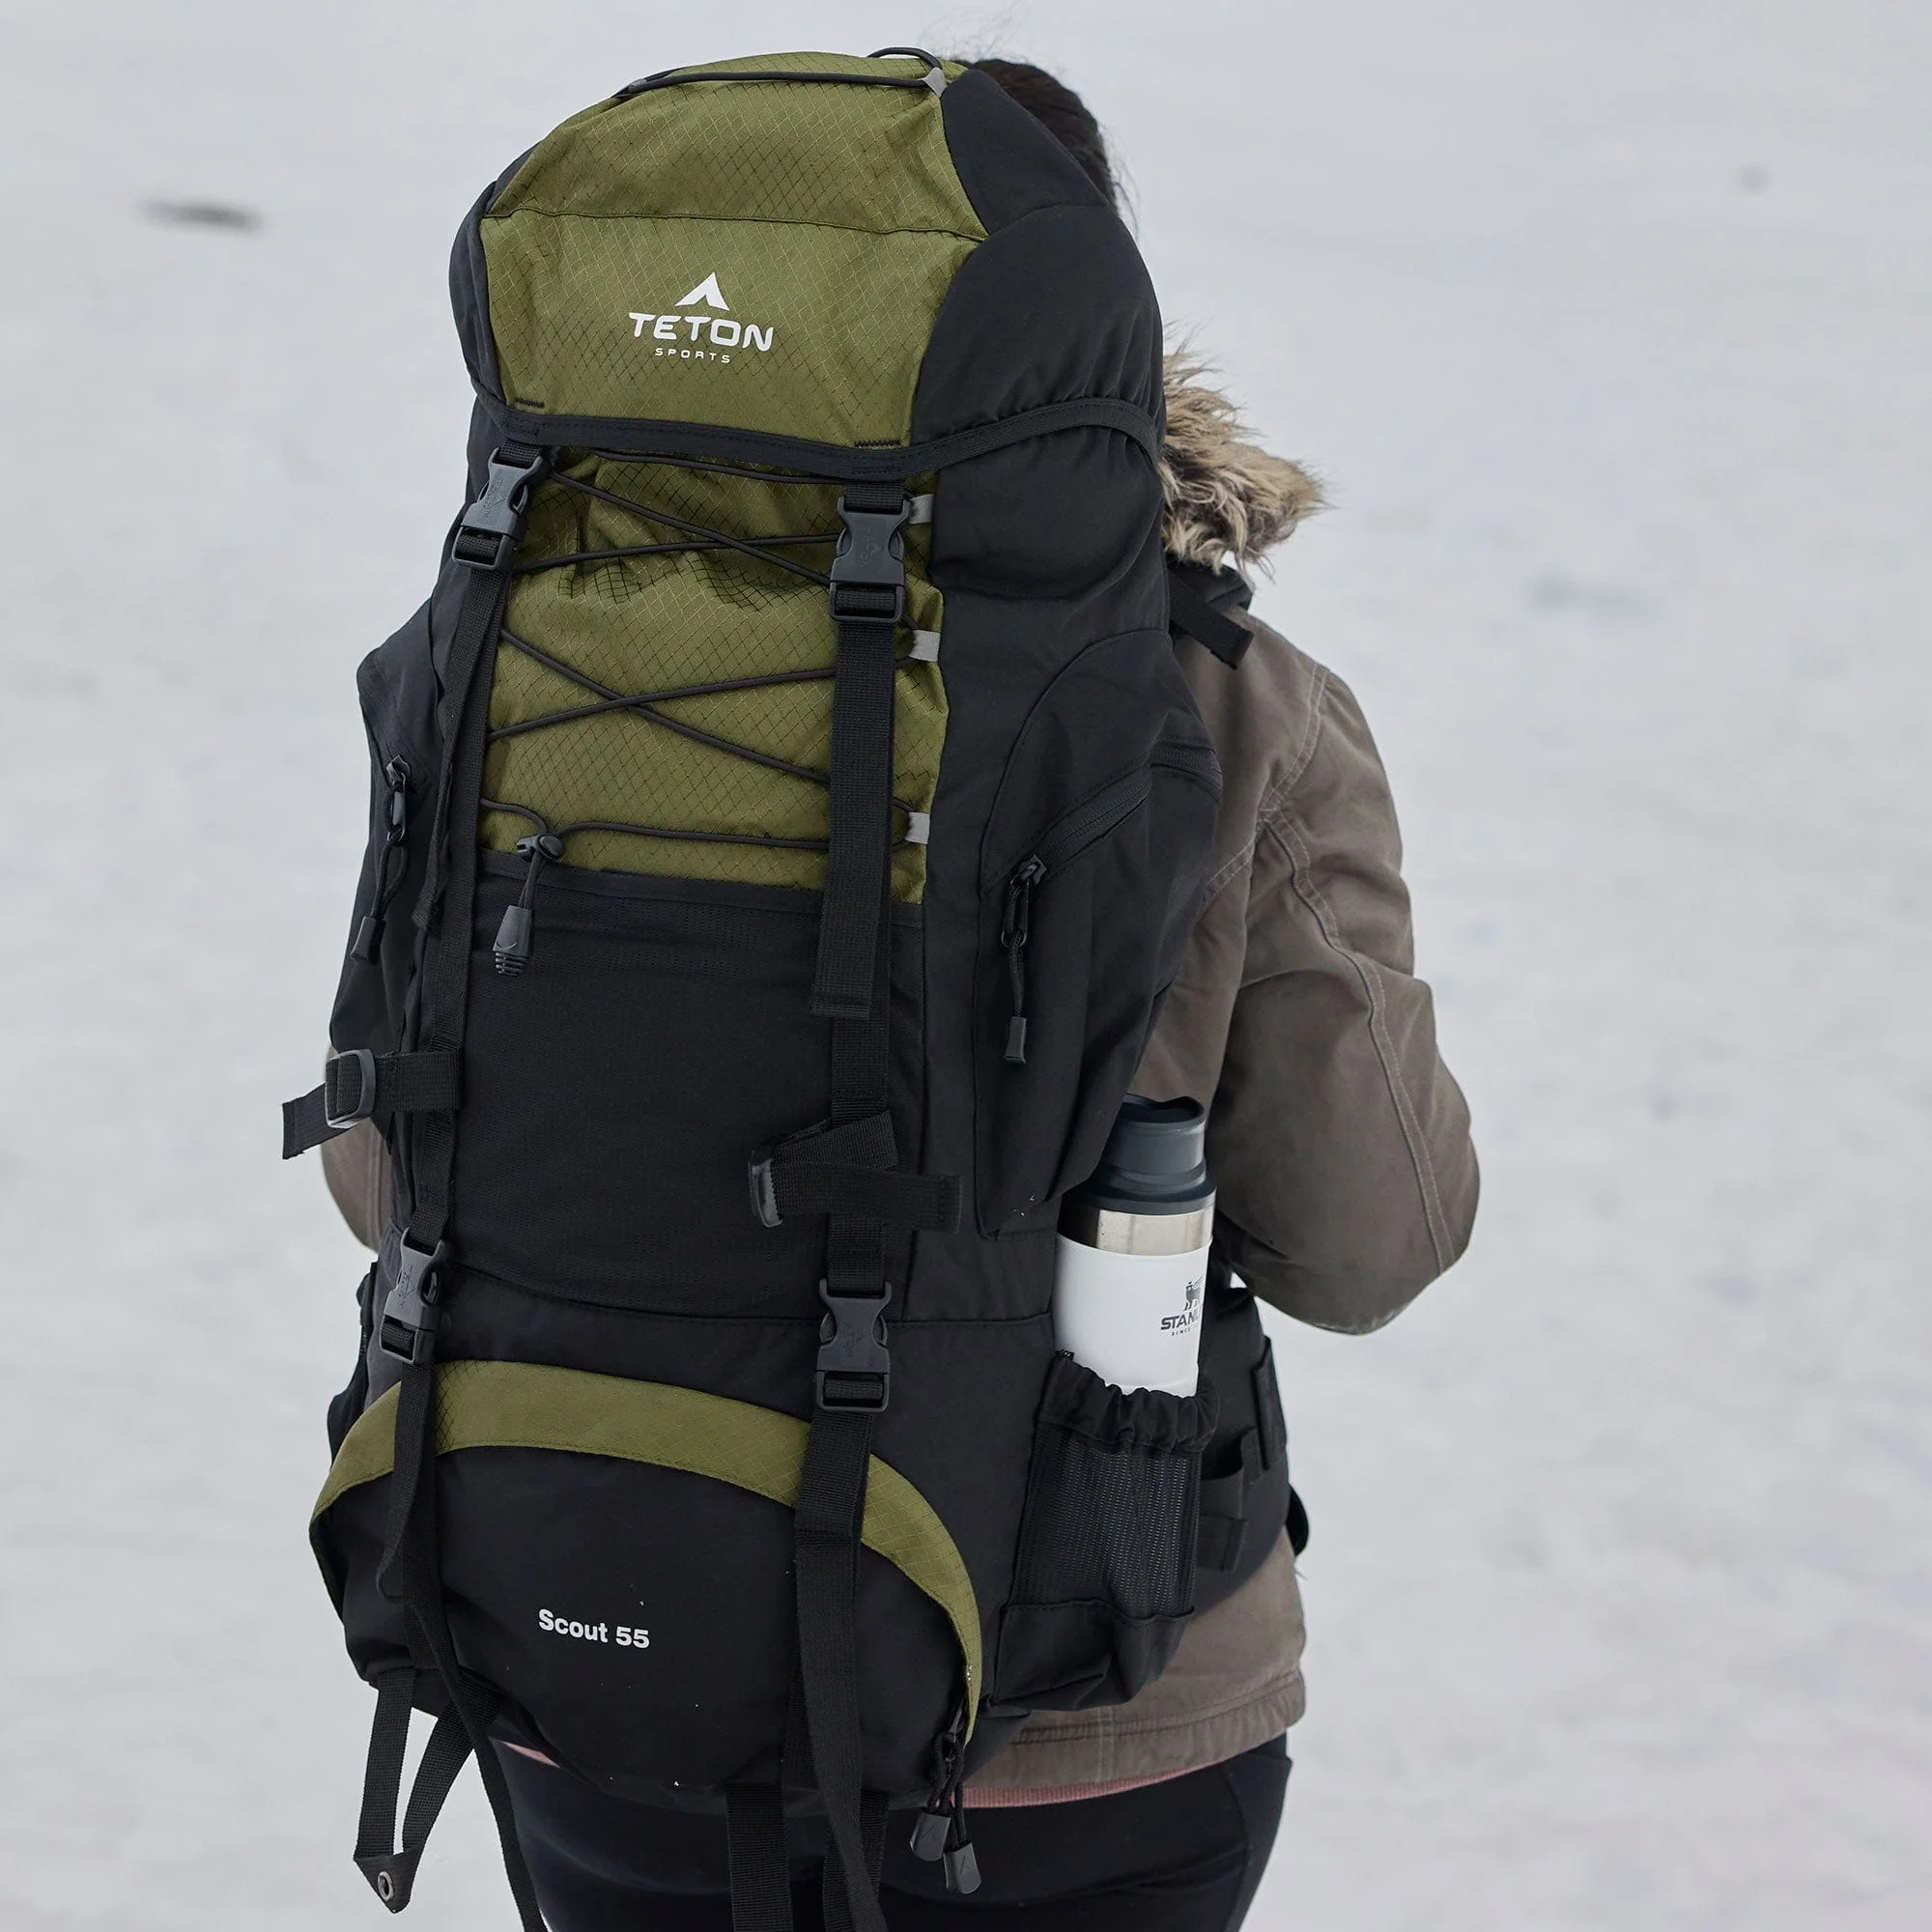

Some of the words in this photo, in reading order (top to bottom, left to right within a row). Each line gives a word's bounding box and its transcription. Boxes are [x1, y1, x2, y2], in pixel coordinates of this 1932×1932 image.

[628, 312, 774, 352] TETON
[655, 347, 730, 364] SPORTS
[538, 1608, 609, 1643] Scout
[615, 1626, 650, 1649] 55
